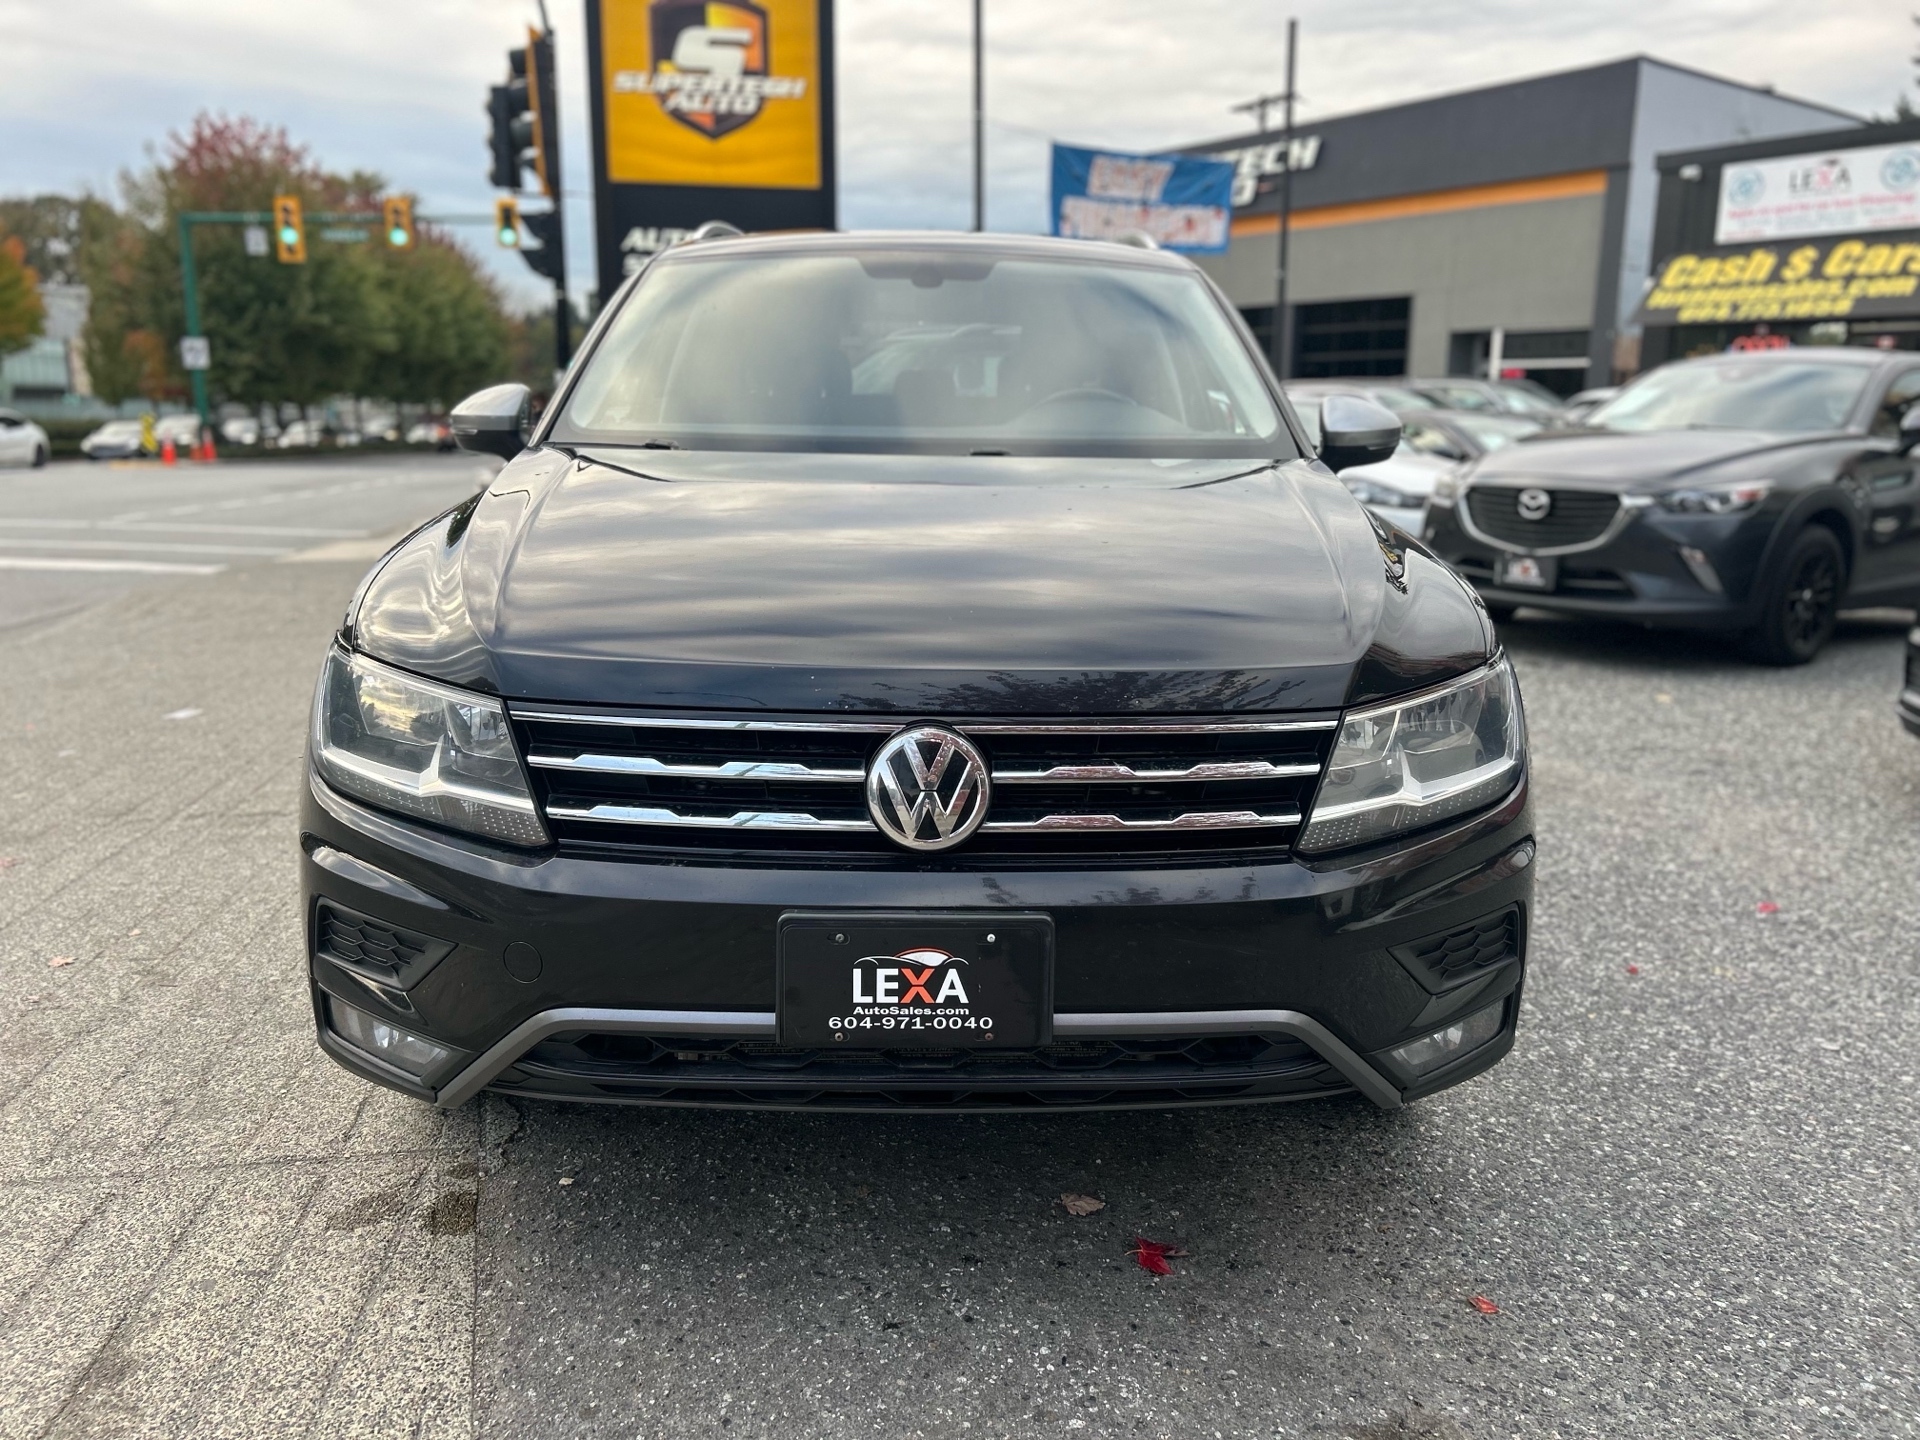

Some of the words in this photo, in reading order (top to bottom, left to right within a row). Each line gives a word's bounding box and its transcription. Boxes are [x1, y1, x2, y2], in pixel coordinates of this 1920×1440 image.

[663, 92, 763, 115] AUTO
[1788, 166, 1852, 193] LEXA
[1660, 248, 1777, 288] Cash
[852, 968, 970, 1004] LEXA
[828, 1016, 994, 1030] 604-971-0040
[853, 1006, 970, 1016] AutoSales.com
